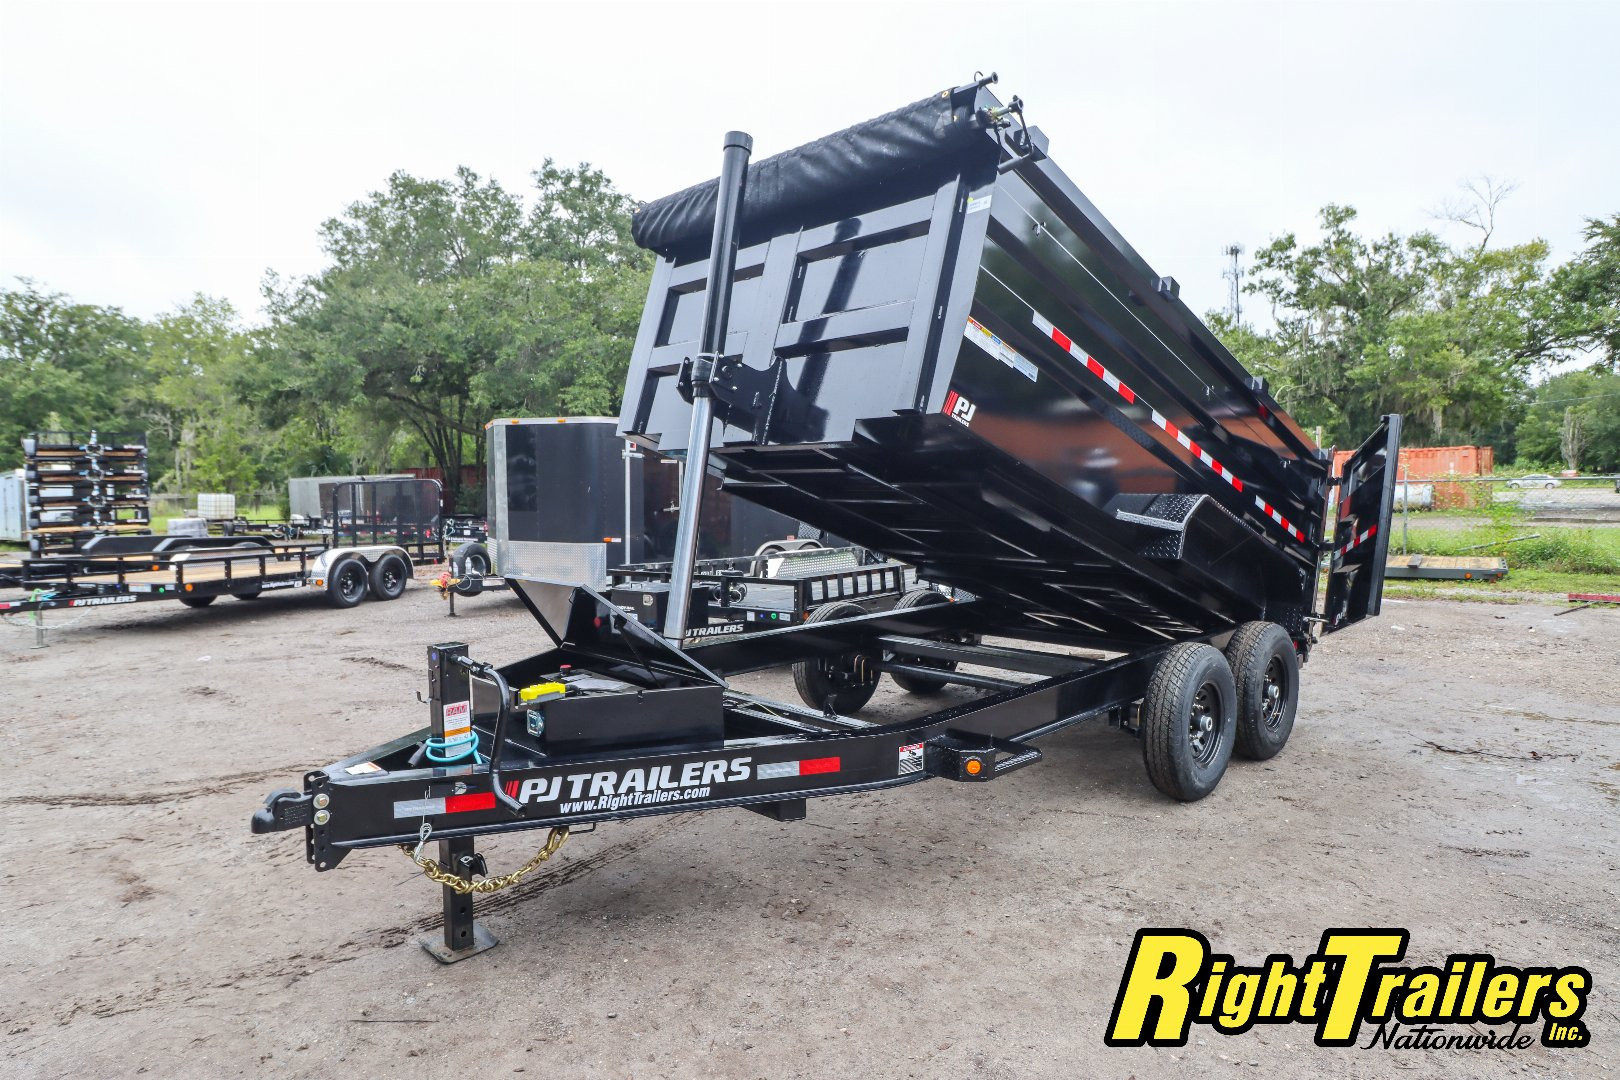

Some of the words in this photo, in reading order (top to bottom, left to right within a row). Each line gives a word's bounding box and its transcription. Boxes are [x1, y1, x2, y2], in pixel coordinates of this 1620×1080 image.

[953, 396, 977, 422] PJ
[86, 595, 137, 606] TRAILERS
[692, 624, 744, 637] TRAILERS
[446, 705, 468, 717] RAM
[518, 776, 563, 804] PJ
[567, 757, 752, 799] TRAILERS
[559, 786, 711, 814] www.RightTrailers.com
